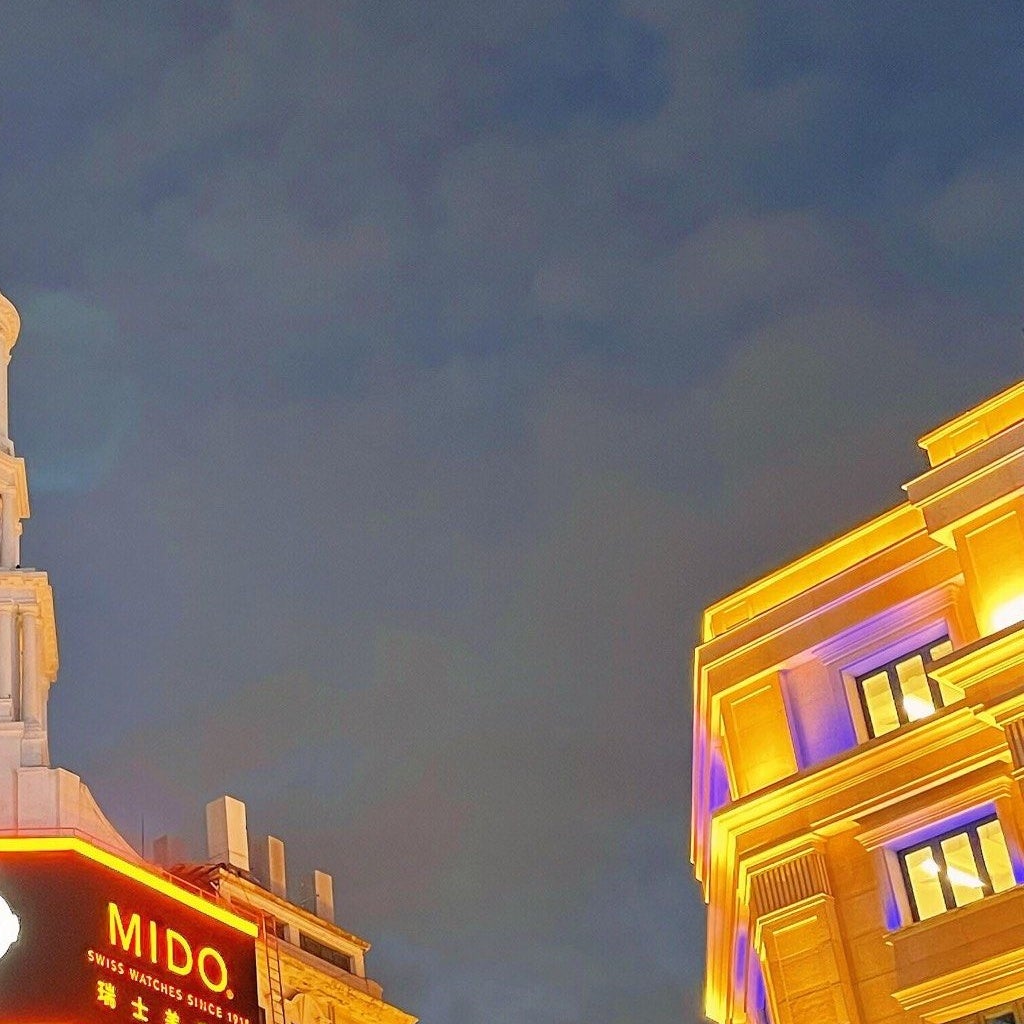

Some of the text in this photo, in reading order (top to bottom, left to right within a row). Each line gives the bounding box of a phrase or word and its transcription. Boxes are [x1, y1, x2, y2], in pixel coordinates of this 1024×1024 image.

[87, 949, 125, 975] SWISS
[128, 967, 183, 1001] WATCHES
[187, 994, 223, 1019] SINCE
[108, 902, 228, 993] MIDO
